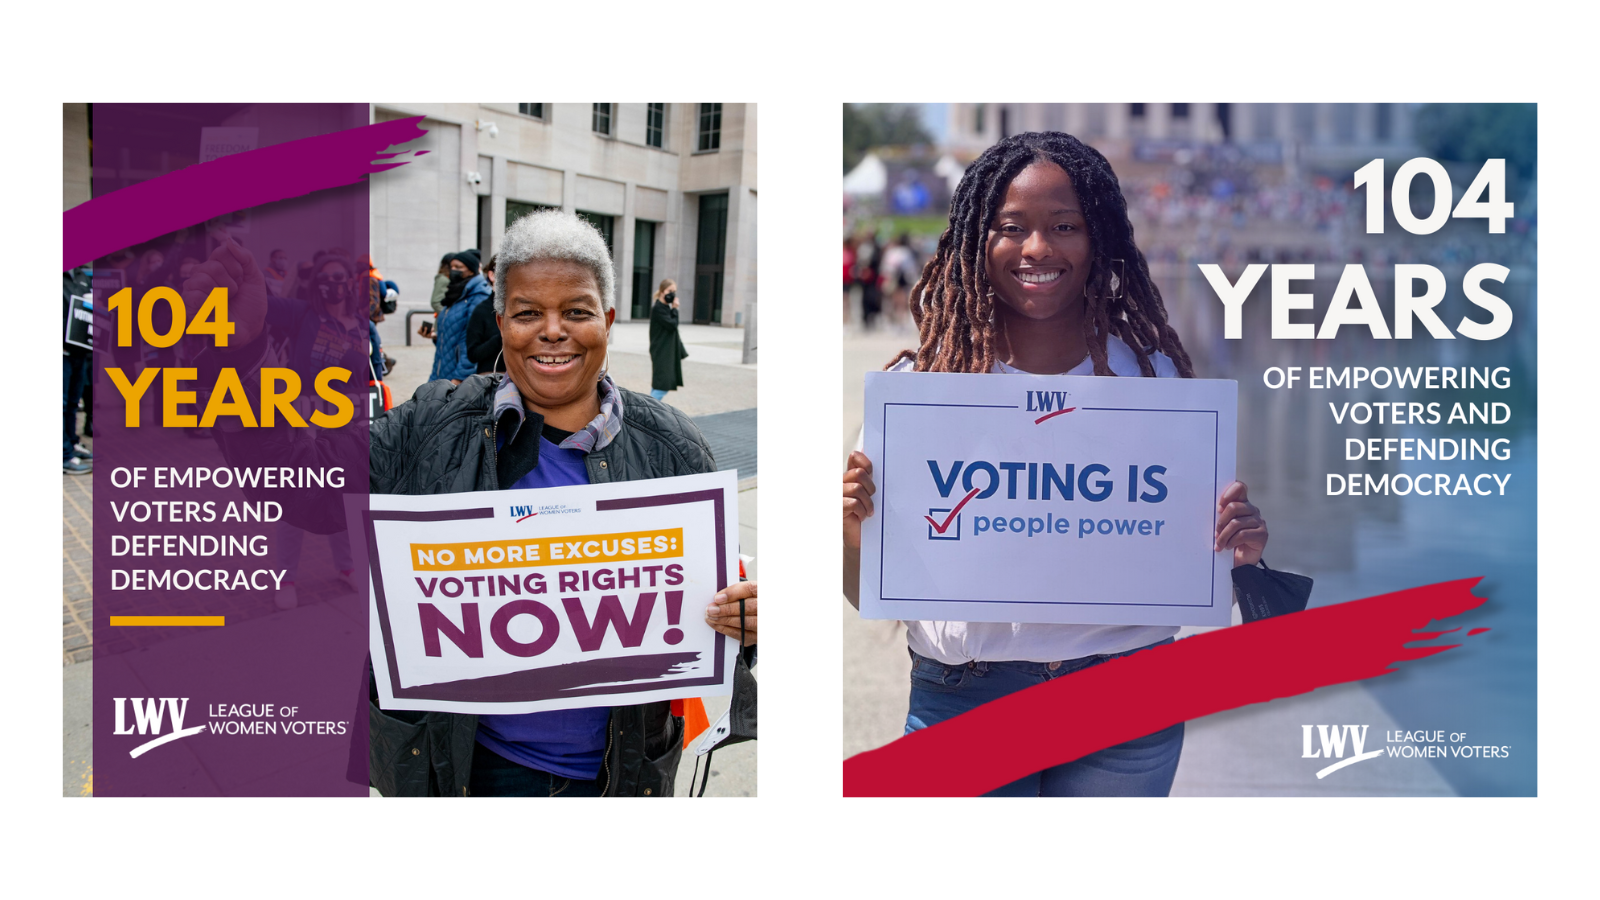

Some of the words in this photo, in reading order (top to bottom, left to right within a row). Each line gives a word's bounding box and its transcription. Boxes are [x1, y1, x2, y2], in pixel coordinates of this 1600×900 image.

[1026, 390, 1068, 412] LWV
[926, 460, 1114, 502] VOTING
[1127, 464, 1169, 504] IS
[509, 504, 533, 517] LWV
[973, 513, 1070, 538] people
[1078, 518, 1165, 539] power
[417, 549, 455, 566] NO
[464, 544, 540, 565] MORE
[549, 535, 677, 560] EXCUSES:
[414, 572, 548, 598] VOTING
[558, 563, 684, 592] RIGHTS
[417, 590, 684, 659] NOW!
